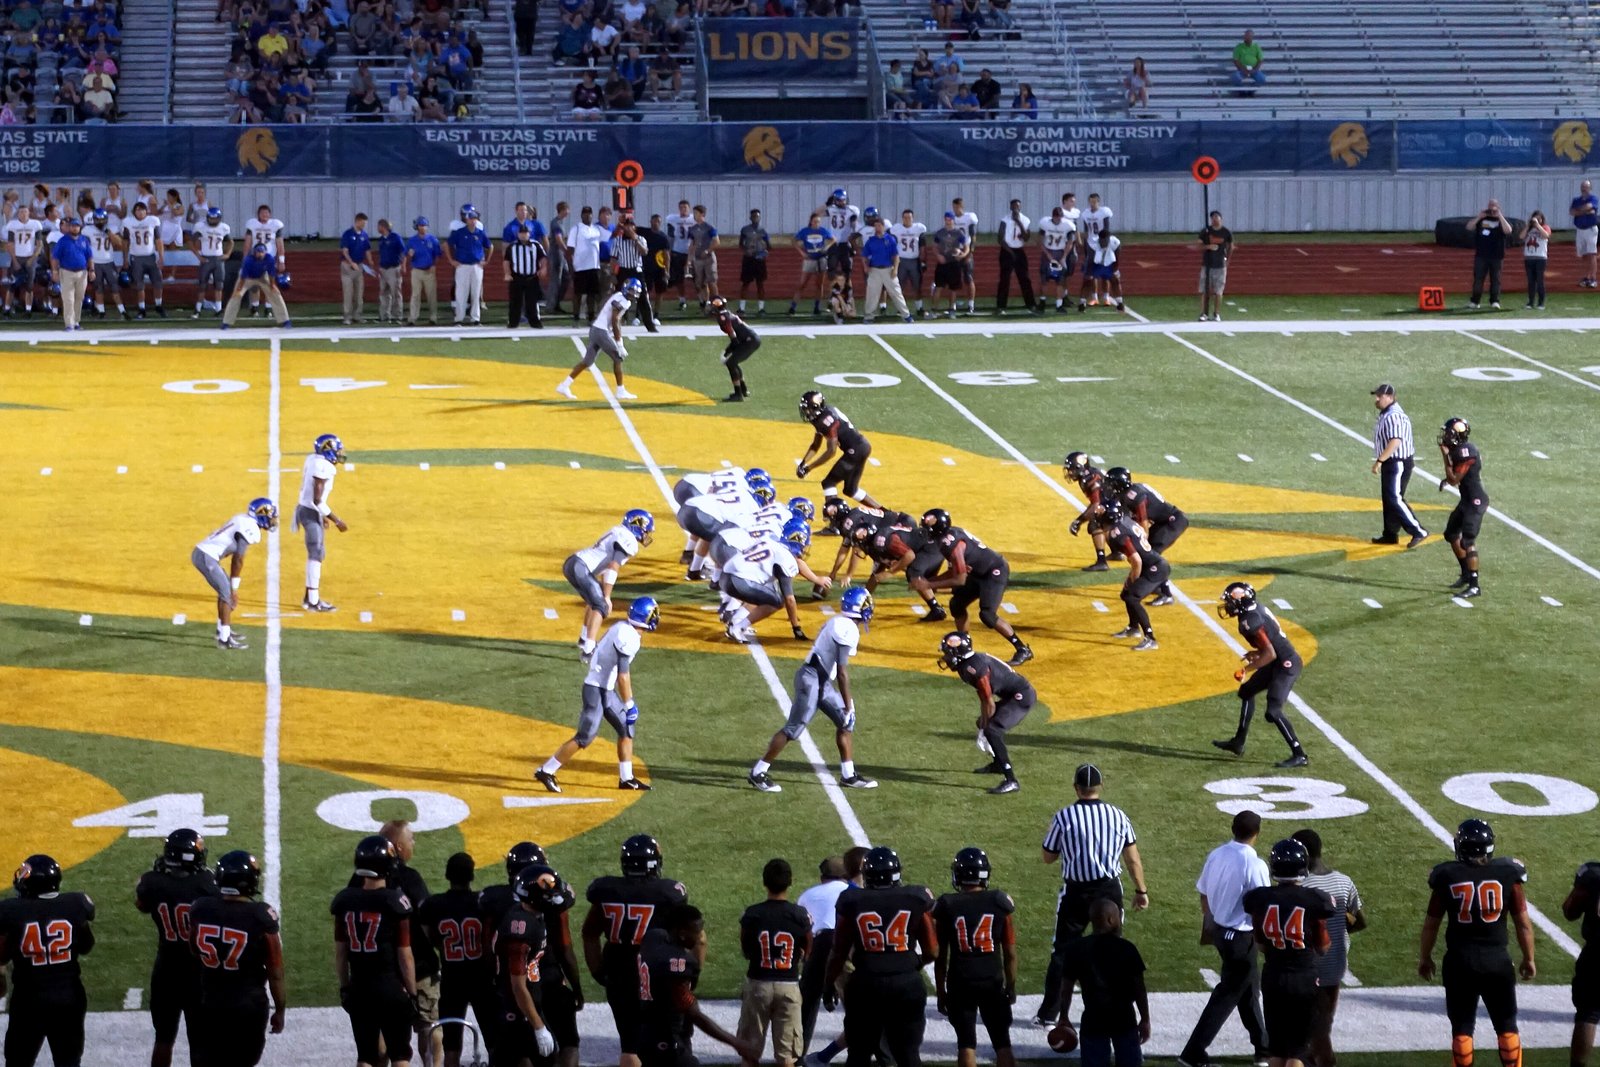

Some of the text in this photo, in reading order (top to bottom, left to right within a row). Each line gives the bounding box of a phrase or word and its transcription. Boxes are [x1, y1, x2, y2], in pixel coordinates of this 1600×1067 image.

[708, 31, 852, 61] LIONS
[0, 131, 88, 144] AS STATE
[426, 129, 597, 142] EAST TEXAS STATE
[961, 126, 1177, 139] TEXAS A&M UNIVERSITY
[1488, 135, 1531, 147] Allstate
[0, 145, 45, 158] LEGE
[457, 144, 566, 157] UNIVERSITY
[1017, 141, 1120, 154] COMMERCE
[473, 159, 551, 171] 1962-1996
[1007, 154, 1130, 168] 1996-PRESENT
[617, 188, 628, 208] 1
[900, 238, 915, 252] 54
[1424, 289, 1443, 306] 20
[1449, 880, 1504, 923] 70
[157, 902, 192, 942] 10
[344, 911, 382, 952] 17
[602, 902, 655, 945] 77
[856, 910, 911, 953] 64
[955, 914, 994, 953] 14
[1263, 904, 1305, 950] 44
[20, 919, 73, 966] 42
[196, 923, 248, 970] 57
[438, 917, 483, 962] 20
[758, 930, 795, 970] 13
